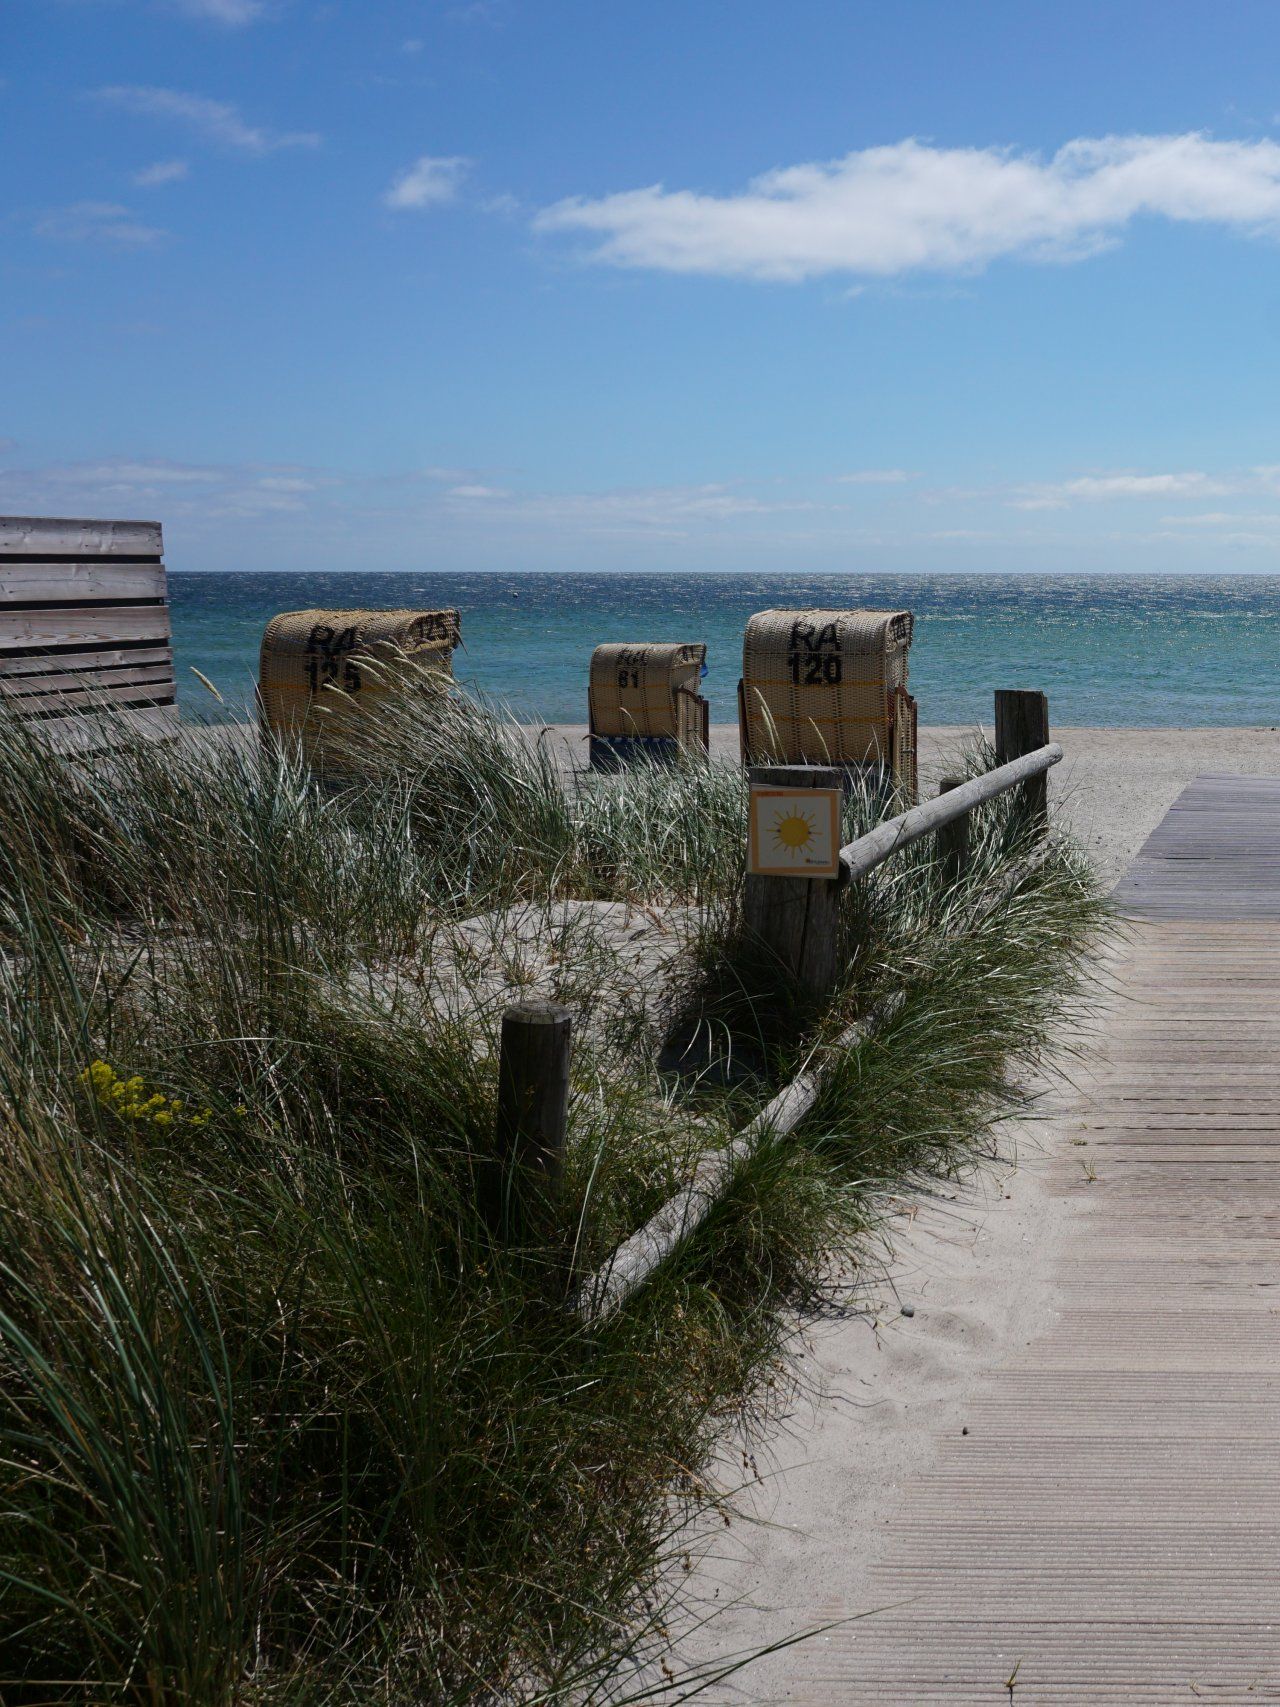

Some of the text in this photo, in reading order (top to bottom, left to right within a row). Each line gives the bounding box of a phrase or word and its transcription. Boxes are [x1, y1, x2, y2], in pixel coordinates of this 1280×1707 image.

[789, 621, 842, 651] RA
[305, 657, 361, 692] 125
[788, 652, 842, 684] 120
